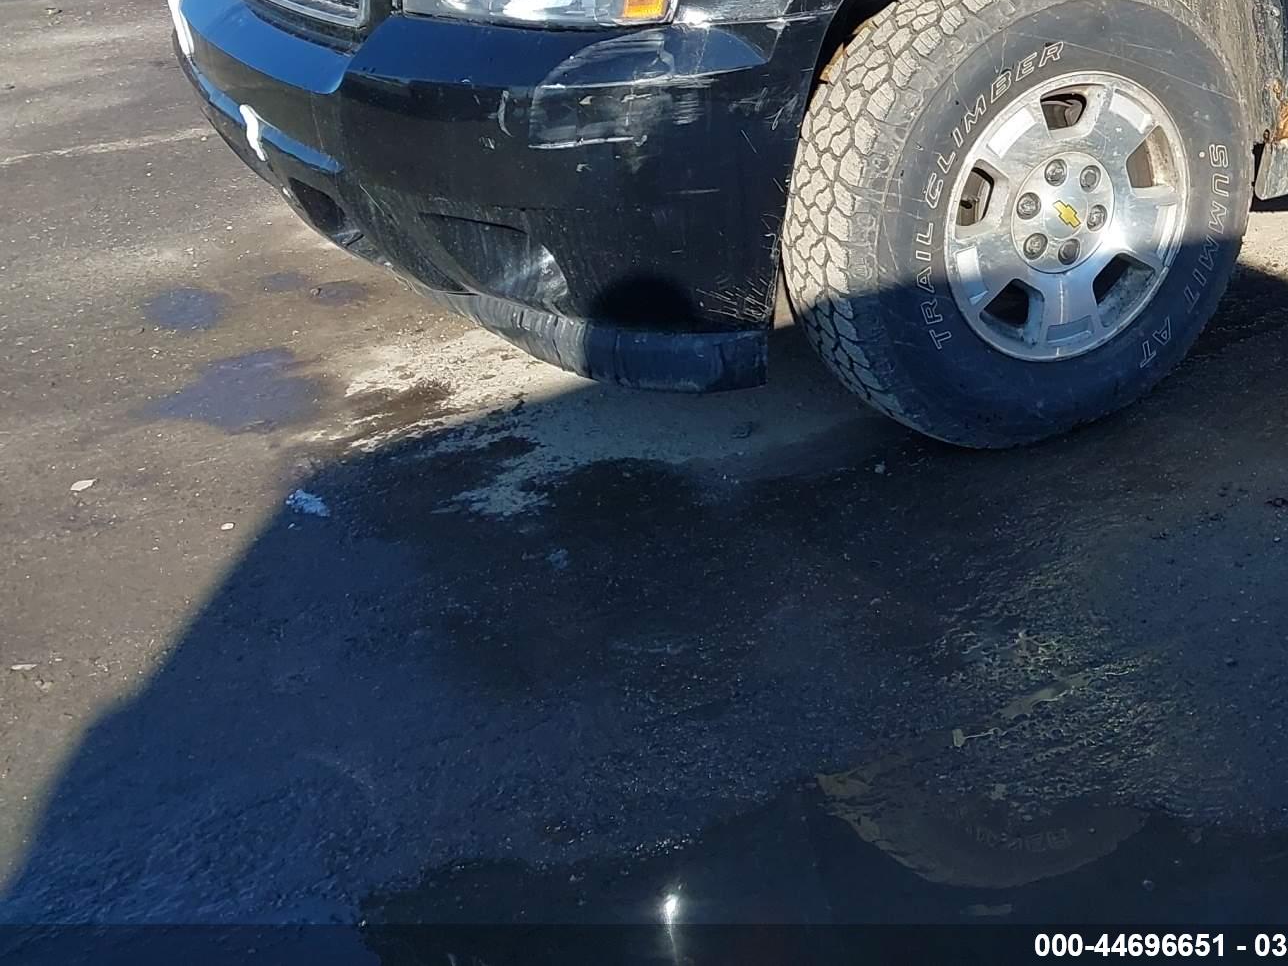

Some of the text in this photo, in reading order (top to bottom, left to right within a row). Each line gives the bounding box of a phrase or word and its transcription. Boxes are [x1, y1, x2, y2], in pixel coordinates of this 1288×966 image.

[915, 41, 1065, 351] TRAIL CLIMBER
[1139, 143, 1230, 369] SUMMIT AT
